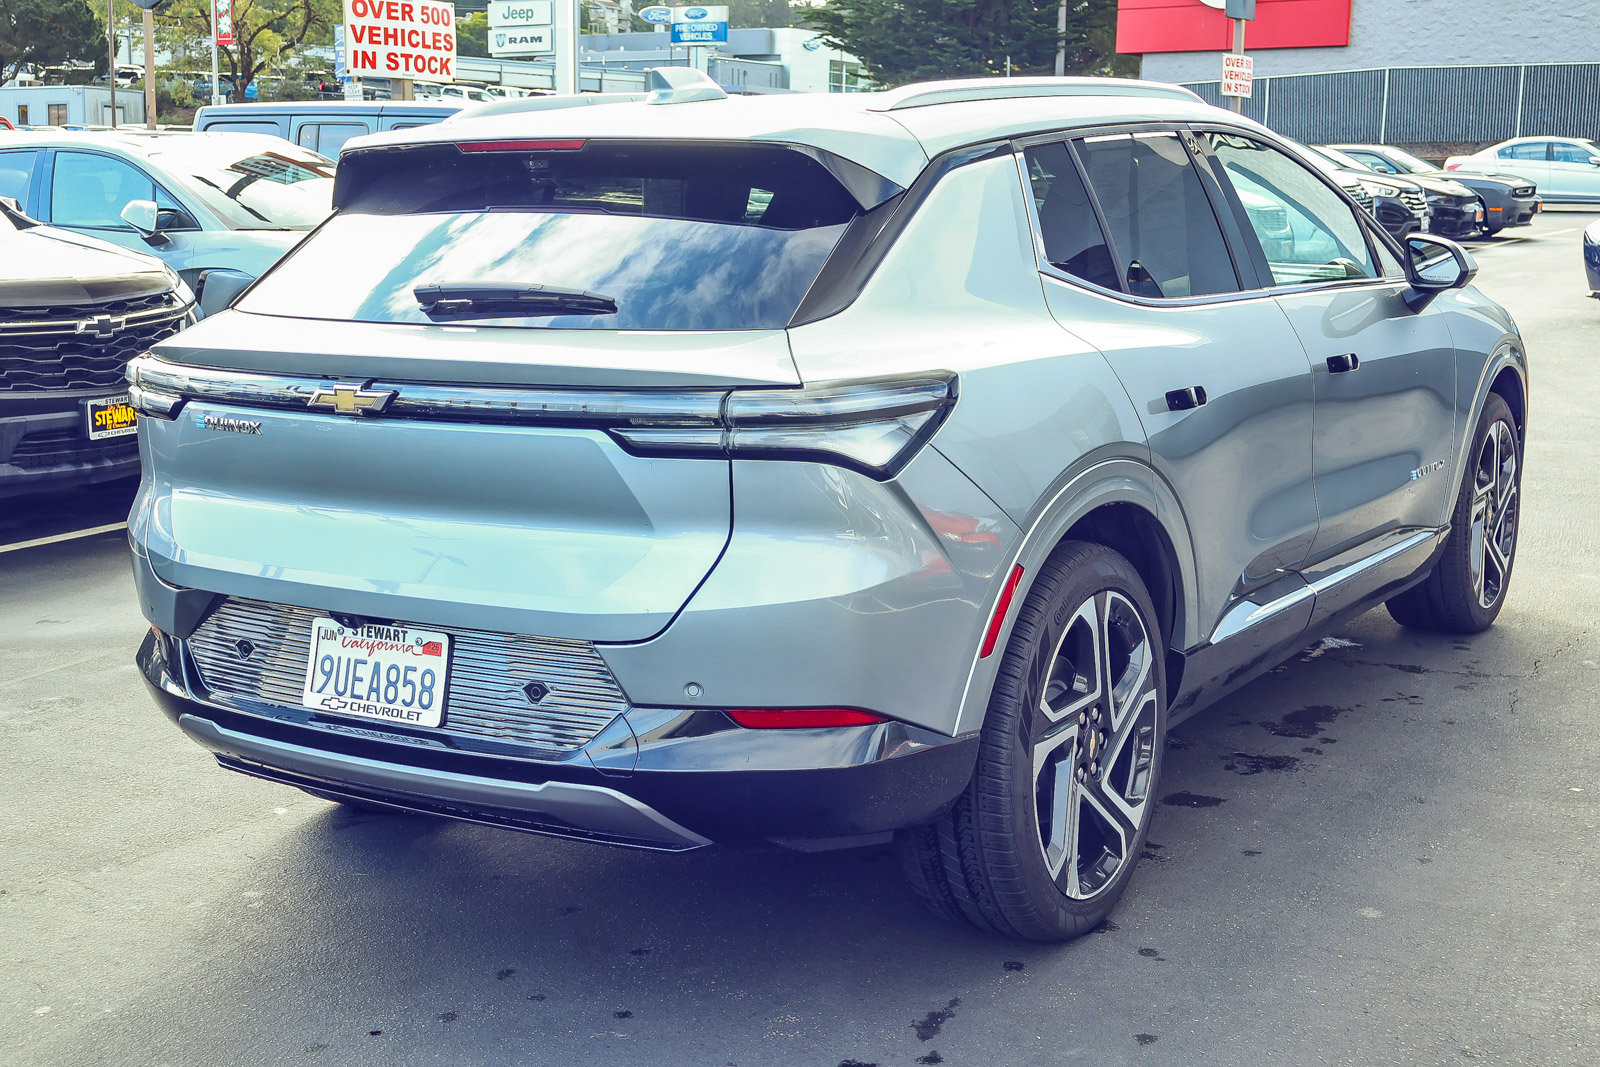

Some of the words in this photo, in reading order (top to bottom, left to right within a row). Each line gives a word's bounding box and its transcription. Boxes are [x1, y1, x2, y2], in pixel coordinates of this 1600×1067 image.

[351, 0, 414, 22] OVER
[420, 5, 450, 26] 500
[502, 6, 534, 21] Jeep
[675, 23, 718, 32] PRE-OWNED
[680, 32, 713, 40] VEHICLES
[350, 24, 453, 52] VEHICLES
[508, 36, 543, 44] RAM
[353, 50, 377, 69] IN
[386, 52, 451, 75] STOCK
[1225, 57, 1244, 68] OVER
[1224, 70, 1252, 82] VEHICLES
[1223, 82, 1232, 92] IN
[105, 396, 128, 404] STEWAR
[95, 407, 136, 426] STEWAR
[195, 414, 263, 435] EQUINOX
[321, 629, 337, 641] JUN
[352, 624, 408, 643] STEWART
[342, 636, 423, 657] California
[317, 654, 435, 710] 9UEA858
[350, 702, 422, 721] CHEVROLET
